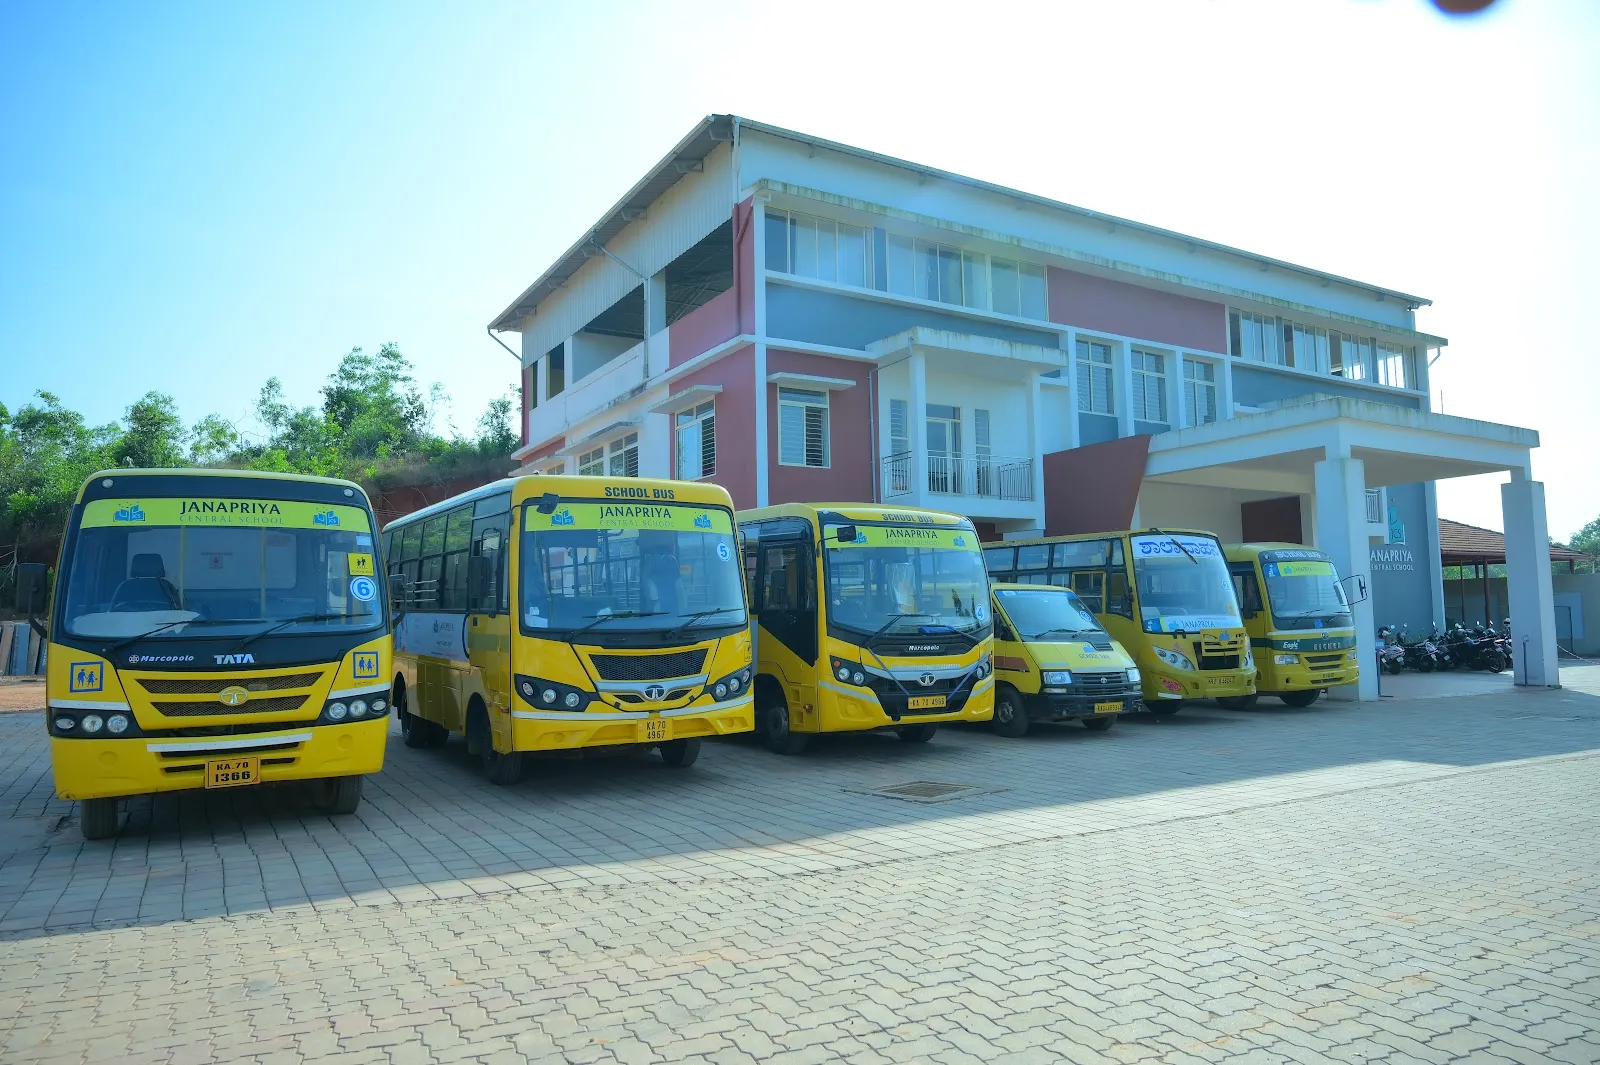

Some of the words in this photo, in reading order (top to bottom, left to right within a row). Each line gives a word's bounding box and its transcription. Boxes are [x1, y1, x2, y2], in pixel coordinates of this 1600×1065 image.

[604, 487, 650, 498] SCHOOL
[653, 489, 675, 499] BUS
[180, 501, 281, 515] JANAPRIYA
[599, 506, 672, 519] JANAPRIYA
[179, 515, 233, 523] CENTRAL
[239, 516, 285, 525] SCHOOL
[599, 519, 640, 527] CENTRAL
[642, 520, 675, 528] SCHOOL
[881, 513, 916, 522] SCHOOL
[917, 515, 934, 524] BUS
[885, 529, 938, 539] JANAPRIYA
[720, 545, 728, 558] 5
[1370, 549, 1413, 562] ANAPRIYA
[1370, 563, 1392, 571] ENTRAL
[357, 581, 370, 596] 6
[1282, 641, 1299, 650] Eagle
[140, 654, 194, 662] Marcopolo
[214, 653, 255, 665] TATA
[646, 721, 656, 731] KA
[657, 720, 666, 730] 70
[647, 730, 666, 740] 4967
[215, 771, 251, 783] 1366
